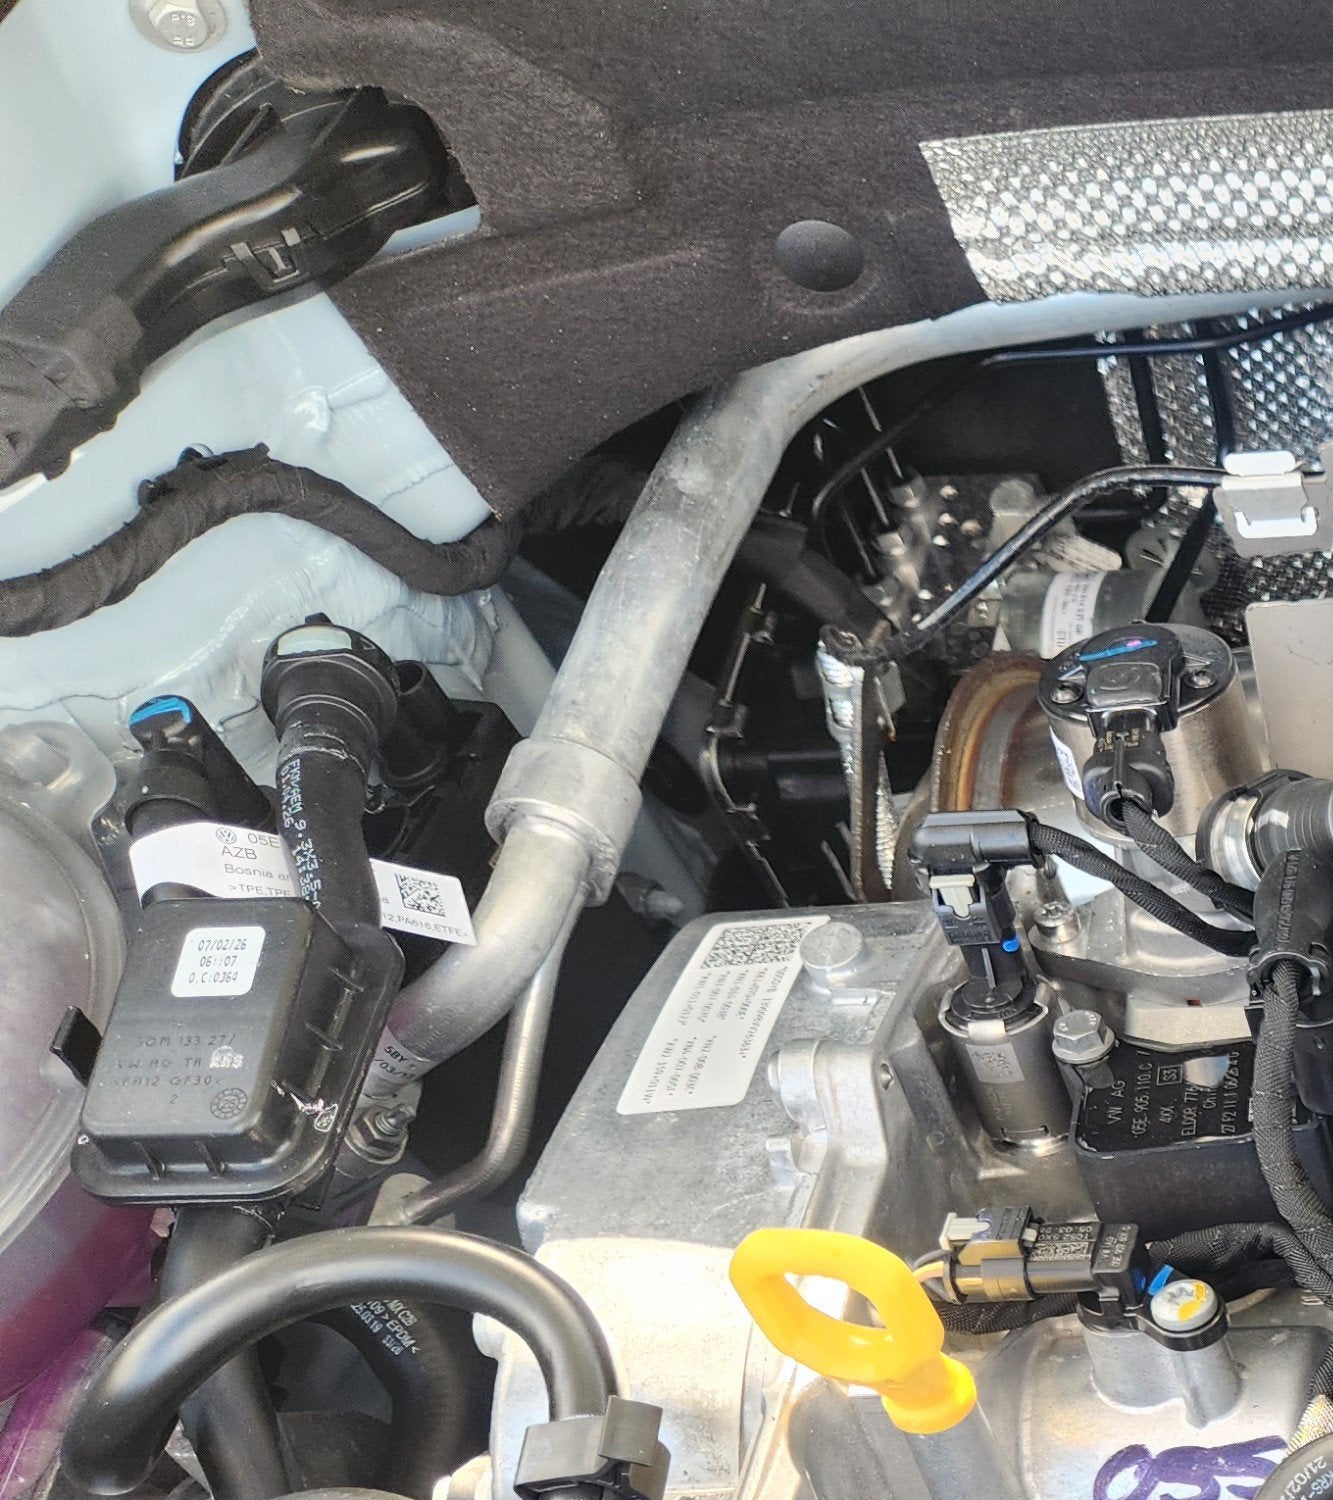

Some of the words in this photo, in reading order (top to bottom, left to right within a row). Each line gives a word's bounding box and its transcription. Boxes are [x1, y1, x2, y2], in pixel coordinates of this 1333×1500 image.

[221, 847, 258, 861] AZB
[224, 863, 274, 880] Bosnia
[198, 938, 247, 951] 07/02/26
[1110, 1080, 1126, 1098] AG
[1107, 1106, 1122, 1125] VW
[386, 1320, 417, 1348] EPDM
